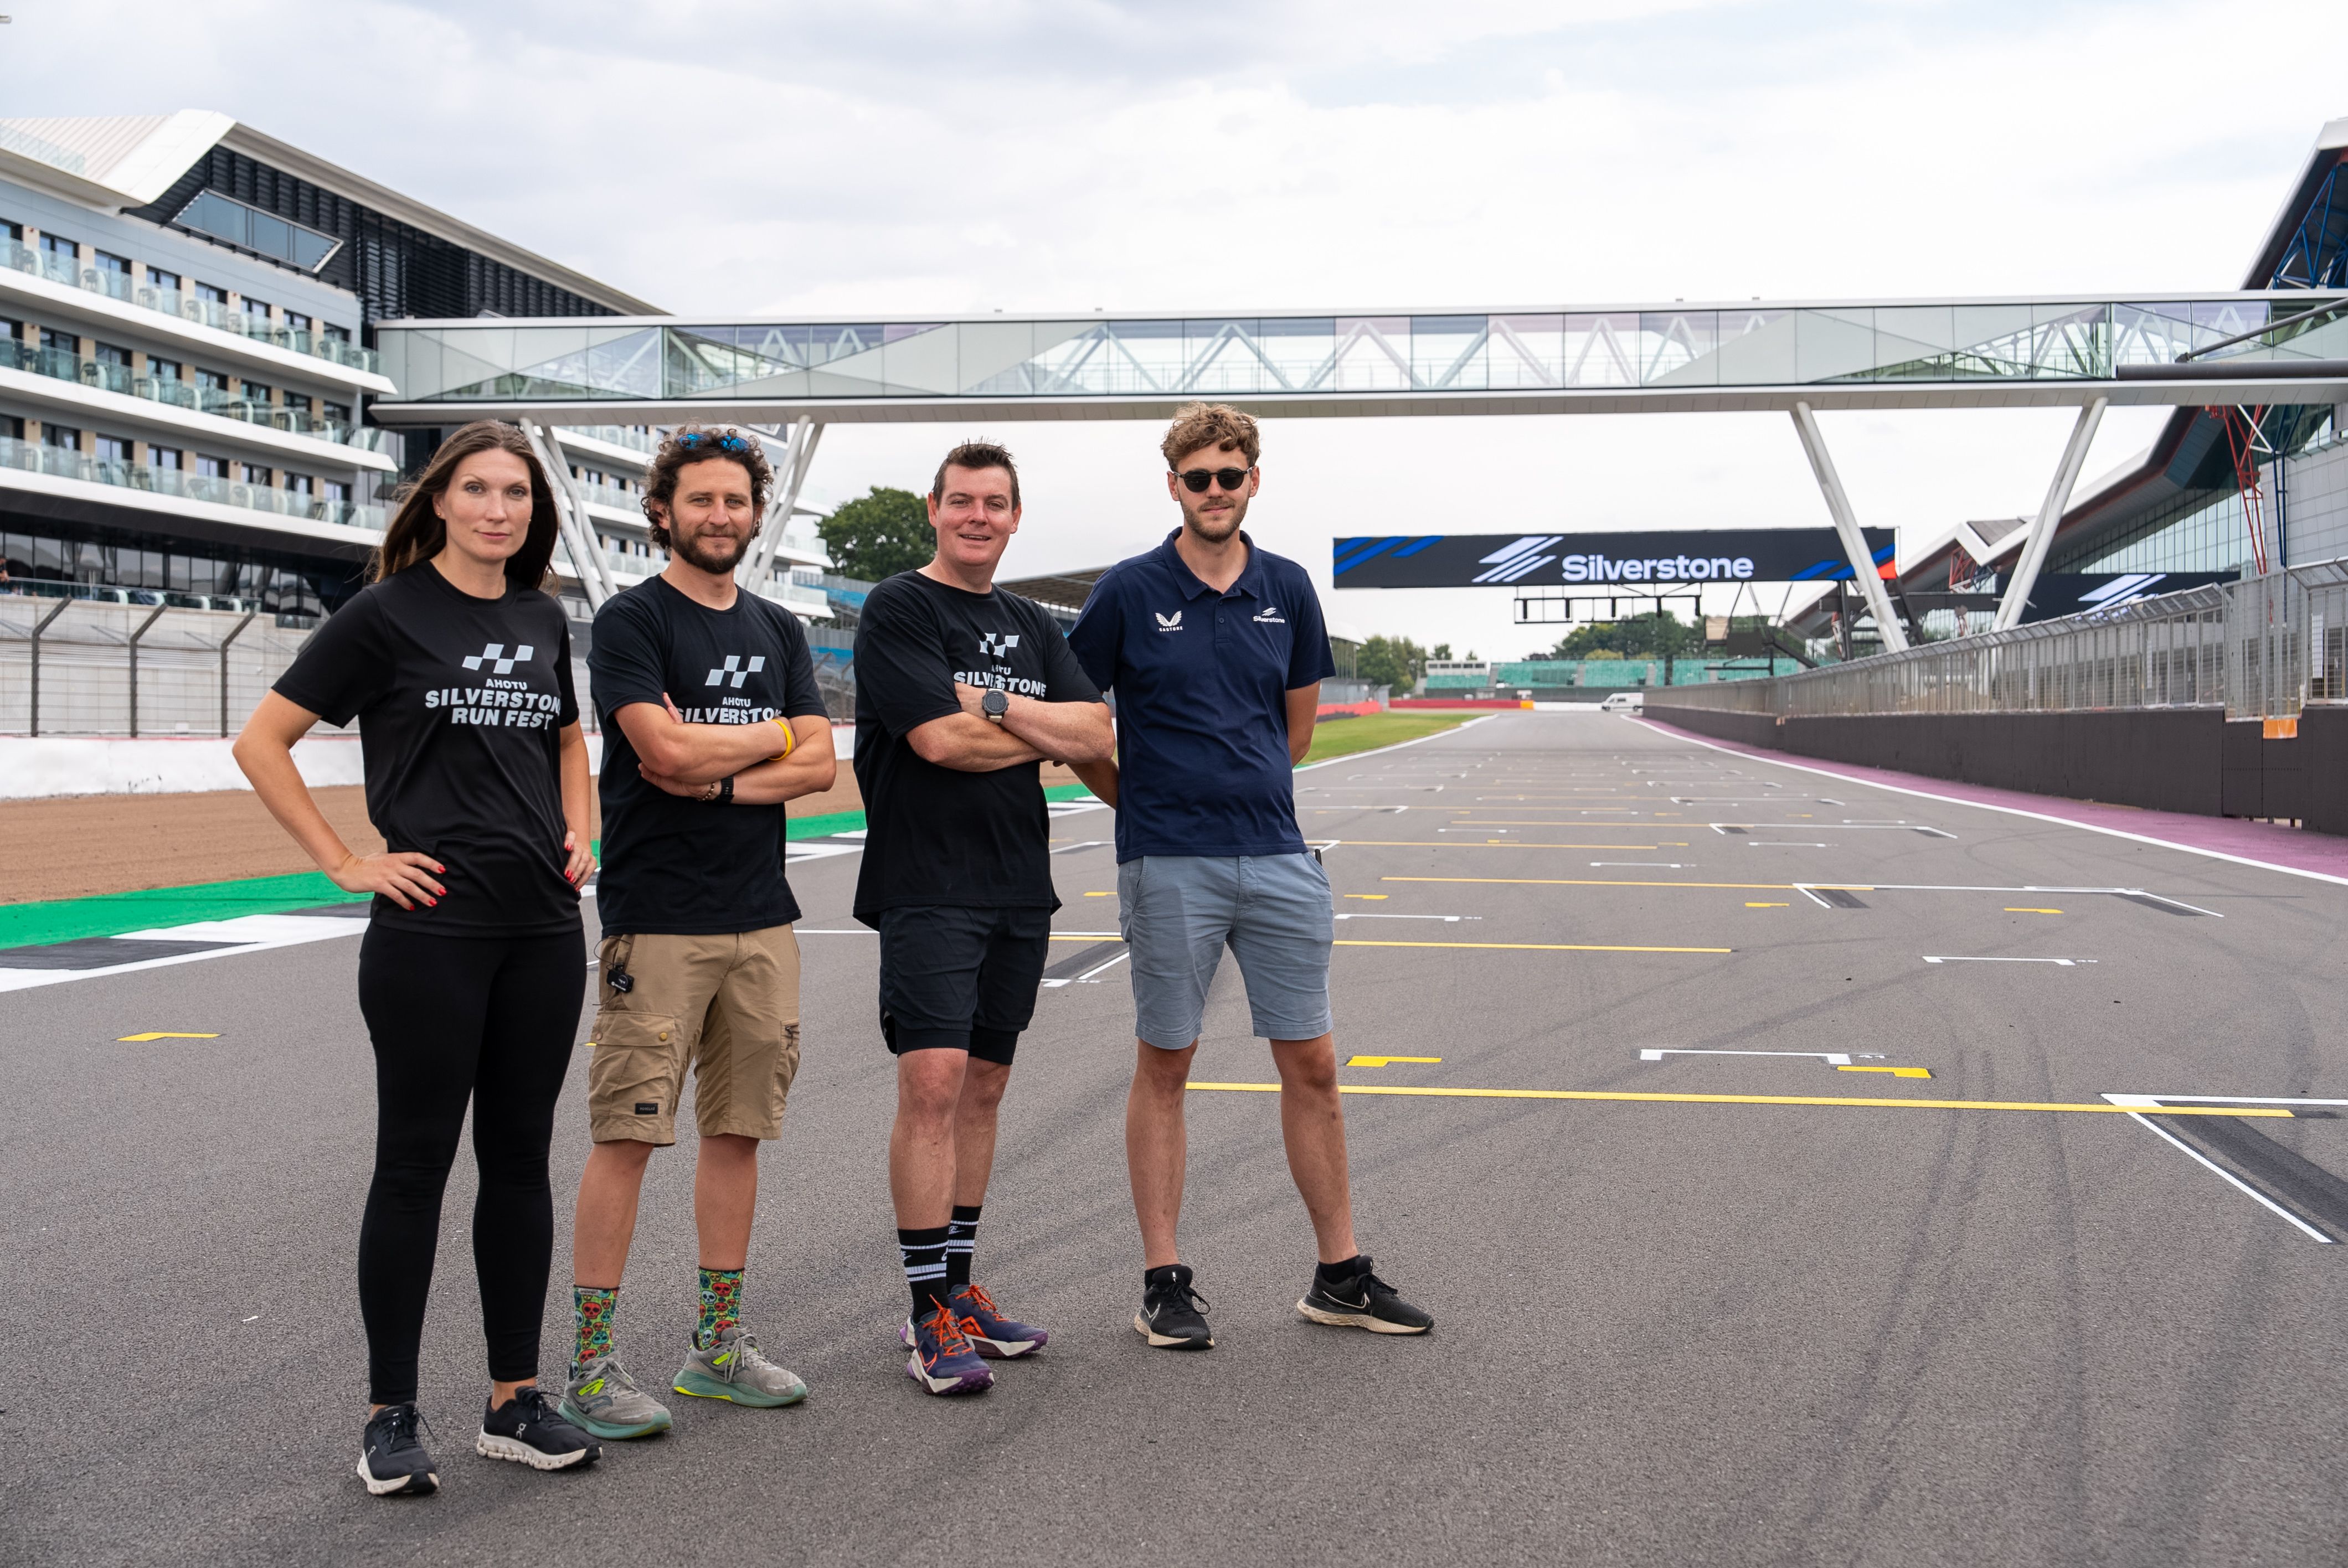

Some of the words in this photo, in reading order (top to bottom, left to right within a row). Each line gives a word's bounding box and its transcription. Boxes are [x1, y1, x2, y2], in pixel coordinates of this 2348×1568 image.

[1562, 554, 1754, 581] Silverstone
[486, 678, 527, 690] AHOTU
[425, 688, 560, 716] SILVERSTON
[722, 696, 751, 708] AHOTU
[451, 708, 500, 726] RUN
[504, 710, 554, 730] FEST
